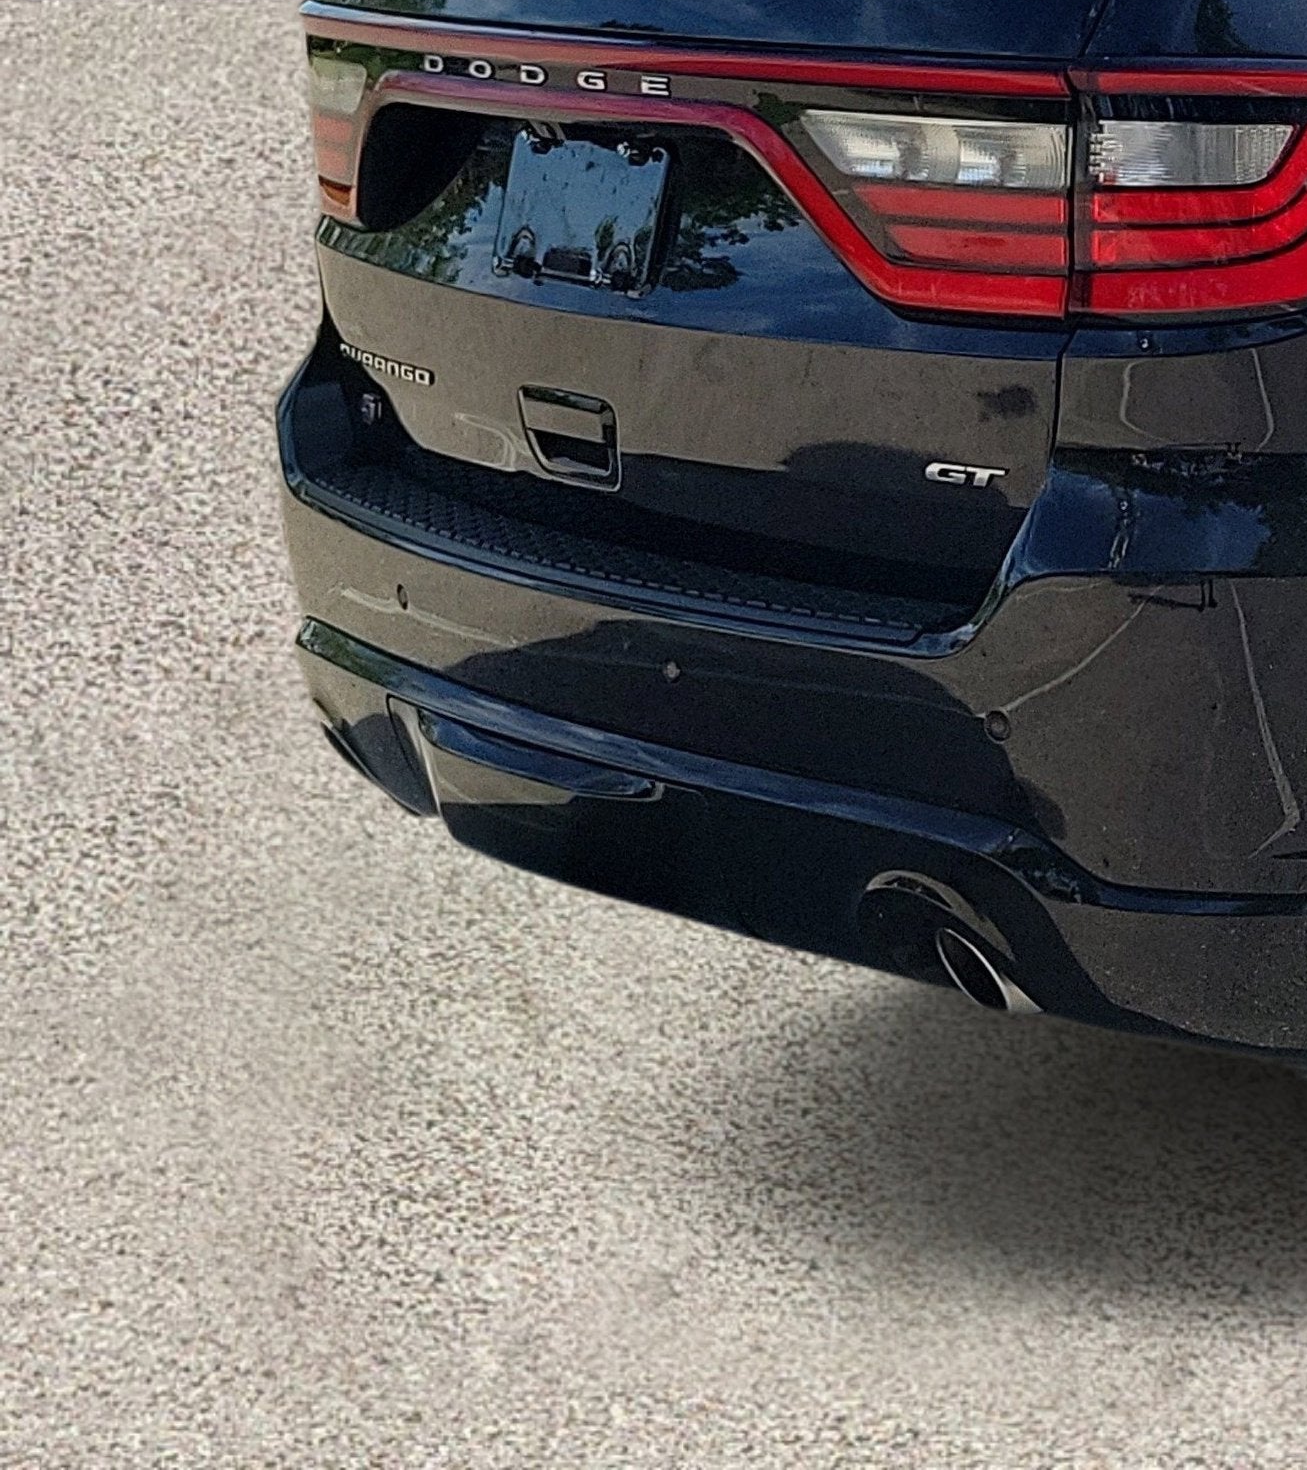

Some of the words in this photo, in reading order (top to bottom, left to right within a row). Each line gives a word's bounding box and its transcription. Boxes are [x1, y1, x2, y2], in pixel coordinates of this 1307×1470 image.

[424, 54, 670, 97] DODGE
[339, 341, 431, 386] DURANGO
[924, 461, 1007, 488] GT
